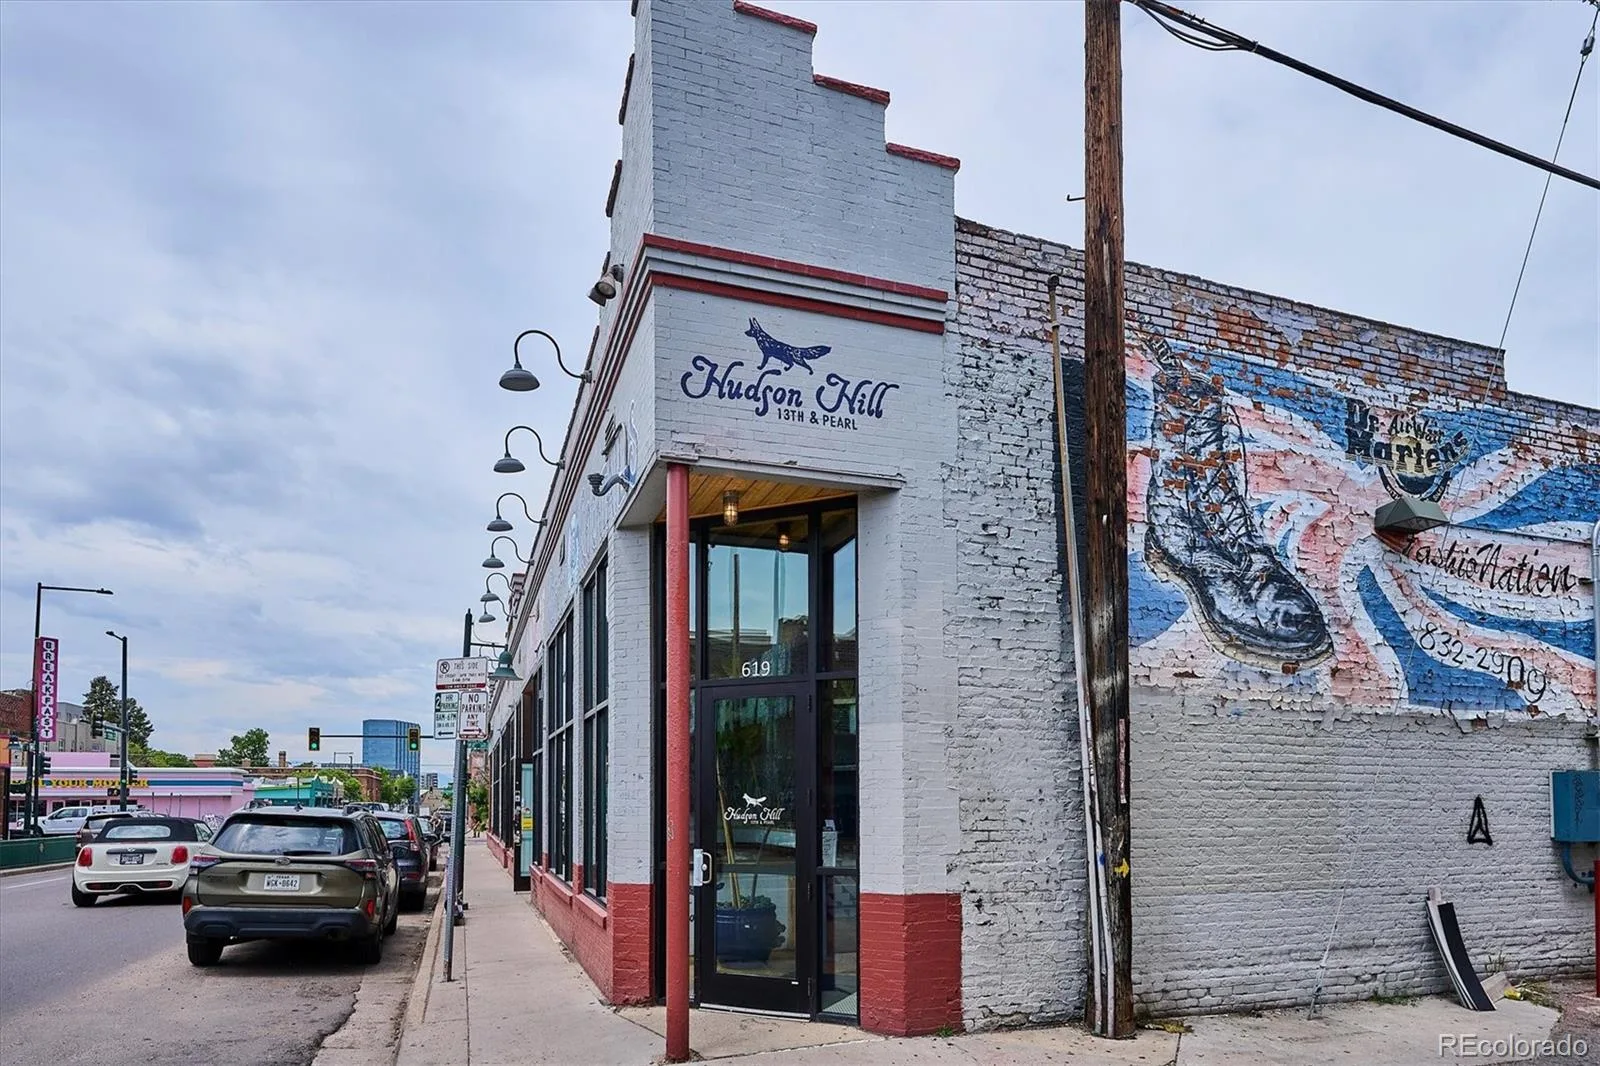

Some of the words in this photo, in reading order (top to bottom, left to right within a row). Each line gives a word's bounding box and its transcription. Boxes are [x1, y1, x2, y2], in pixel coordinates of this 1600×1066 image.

[681, 355, 803, 417] Hudson
[815, 373, 899, 418] Hill
[777, 407, 804, 423] 13TH
[809, 411, 819, 425] &
[822, 414, 858, 430] PEARL
[741, 660, 771, 678] 619
[1419, 621, 1546, 703] 832-2909
[43, 641, 53, 737] BREAKFAST
[468, 693, 480, 703] NO
[435, 695, 441, 710] 2
[445, 694, 454, 702] HR
[461, 703, 486, 713] PARKING
[51, 778, 88, 788] YOUR
[93, 778, 149, 788] MOTER
[724, 806, 758, 825] Hudson
[760, 806, 786, 821] Hill
